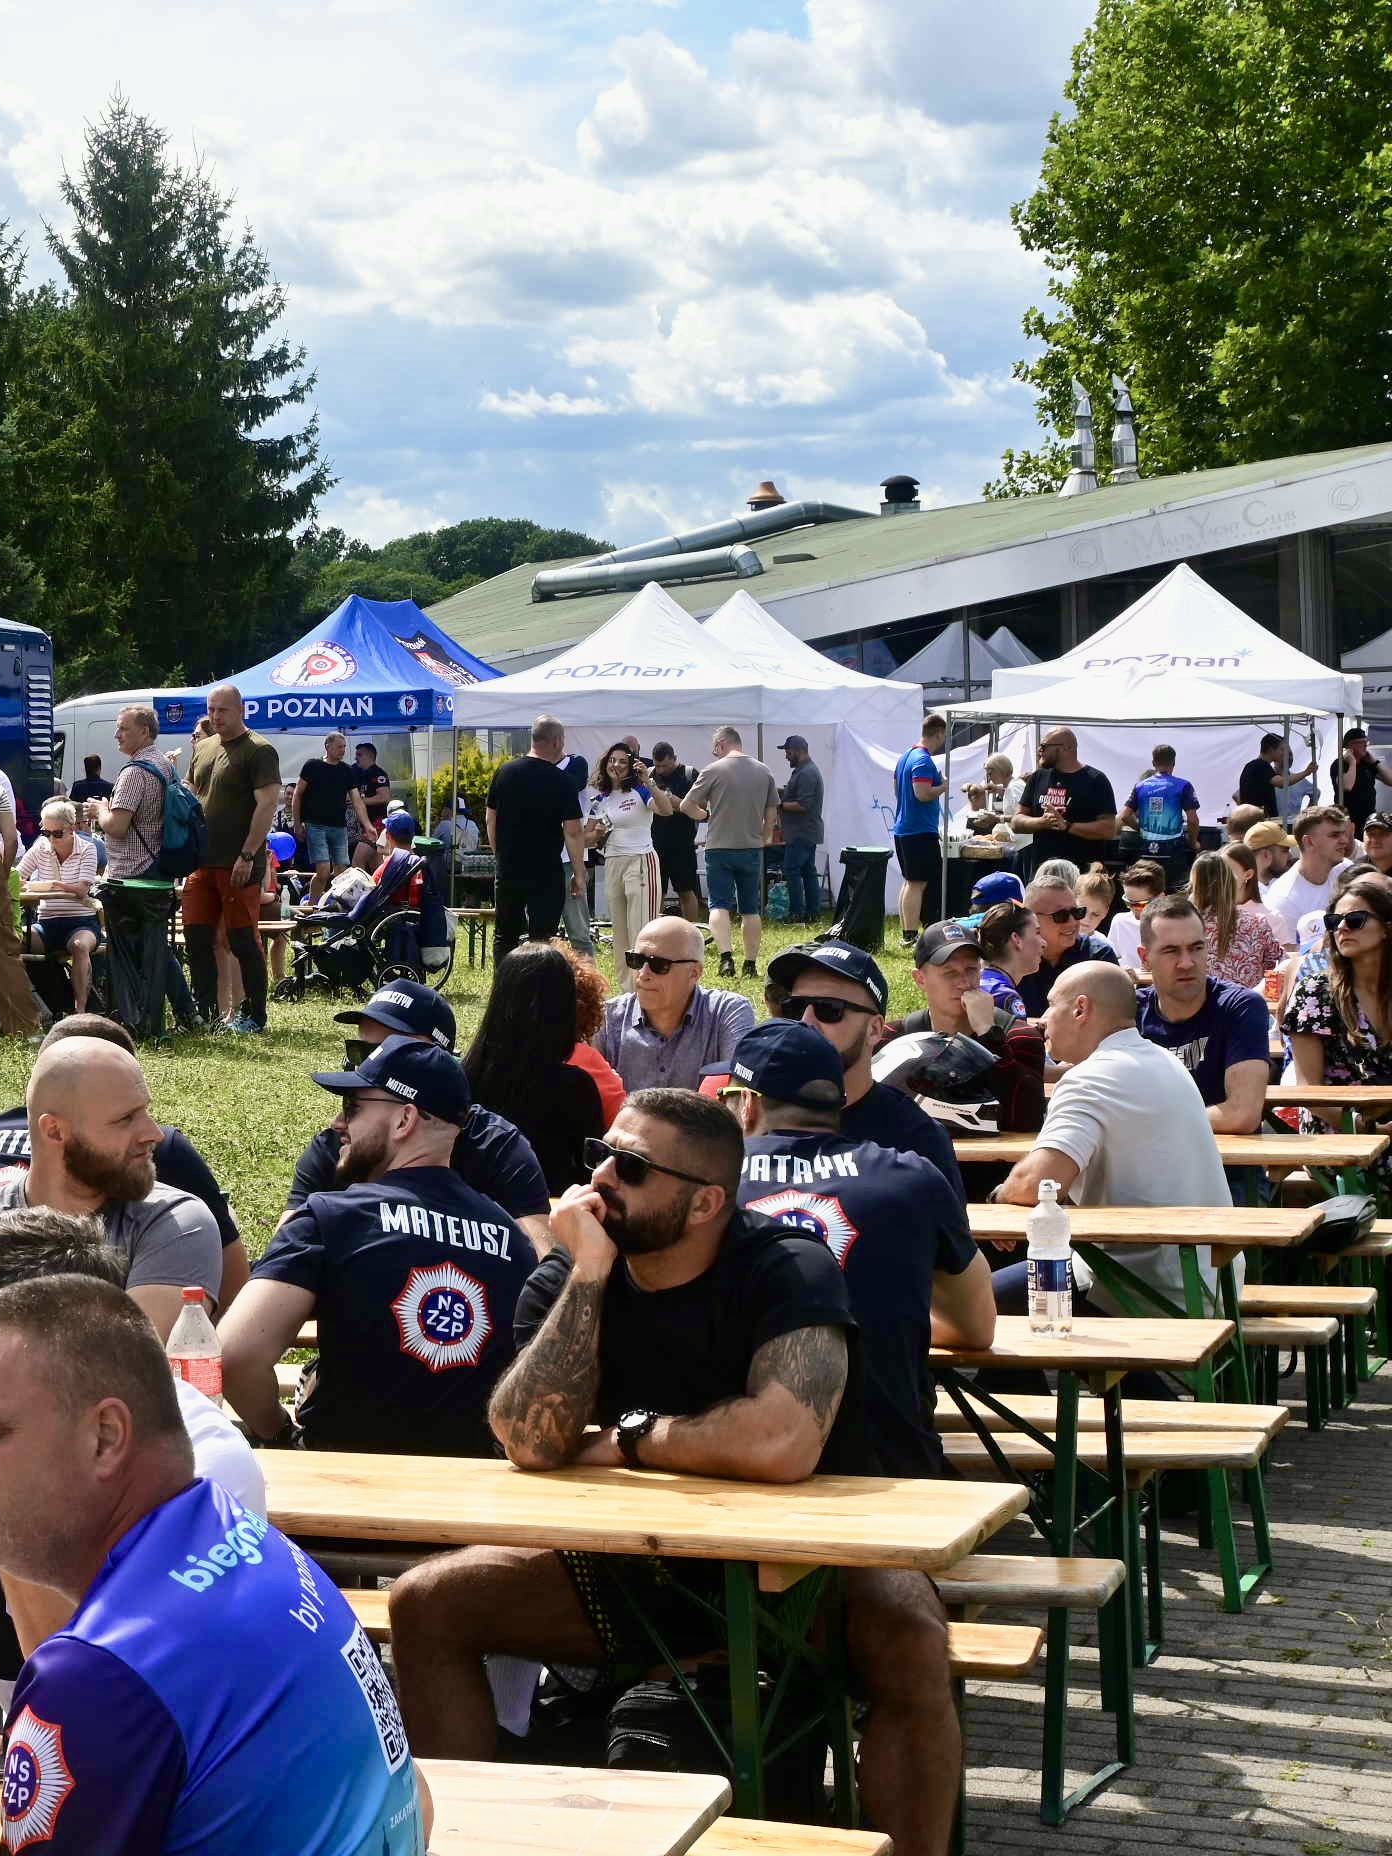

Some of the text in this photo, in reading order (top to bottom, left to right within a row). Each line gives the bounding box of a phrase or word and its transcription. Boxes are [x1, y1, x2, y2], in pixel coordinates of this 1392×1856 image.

[1242, 500, 1297, 526] CLUB
[267, 695, 374, 718] POZNAŃ
[385, 1076, 419, 1100] MATEUSZ
[379, 1202, 512, 1262] MATEUSZ
[782, 1215, 816, 1233] NS
[438, 1295, 465, 1320] NS
[426, 1309, 464, 1337] ZZP
[289, 1593, 325, 1633] by
[8, 1753, 31, 1783] NS
[3, 1776, 30, 1808] ZZP
